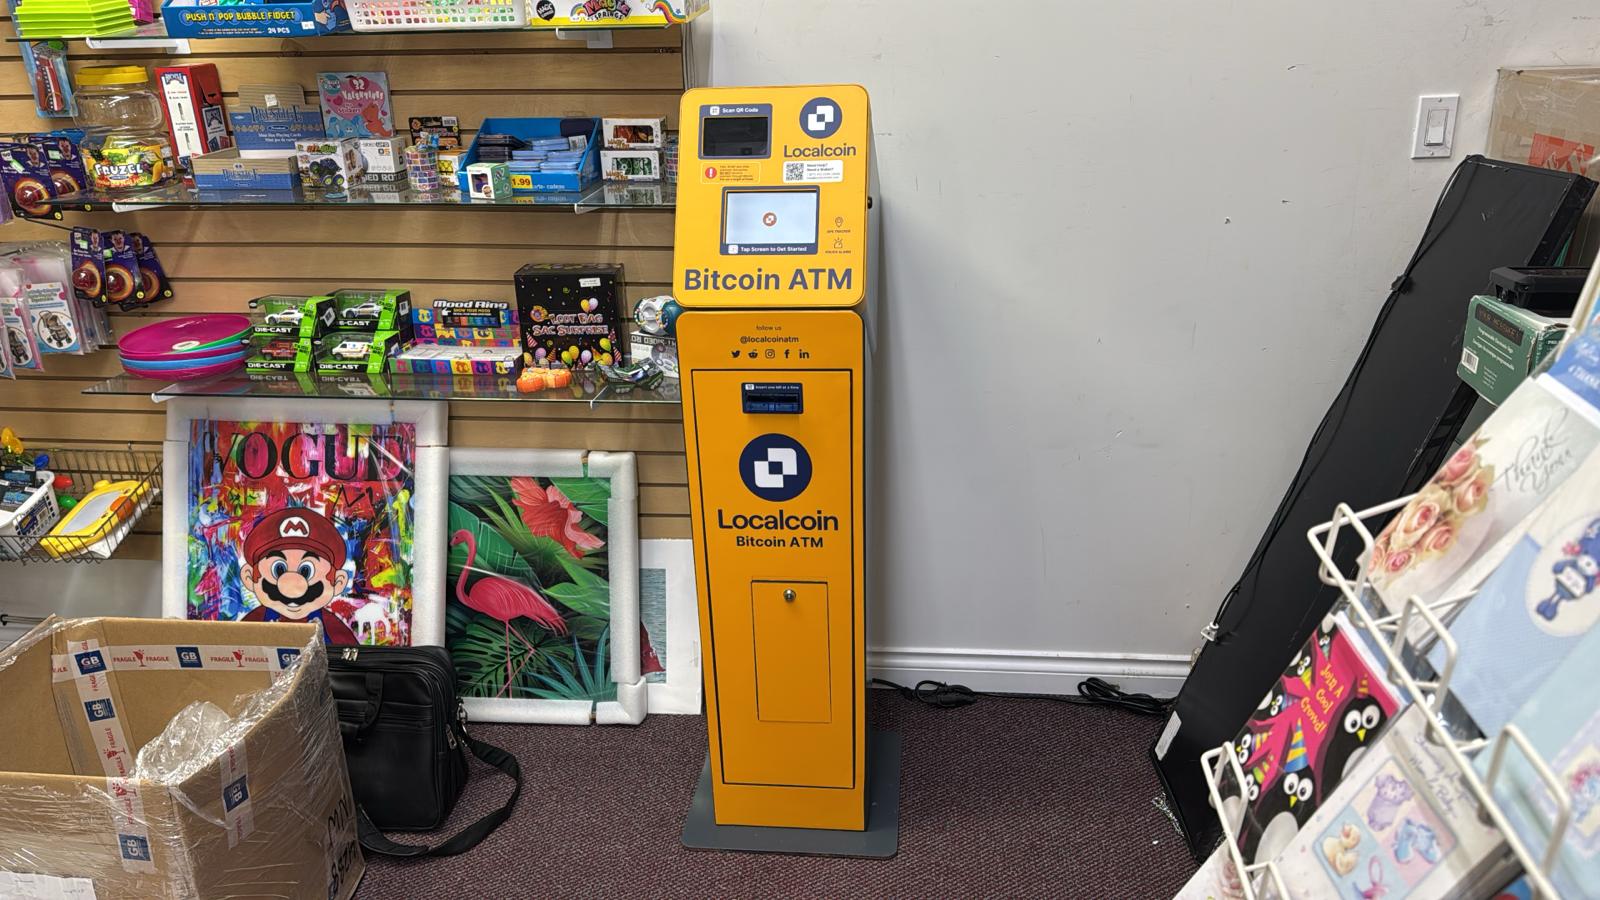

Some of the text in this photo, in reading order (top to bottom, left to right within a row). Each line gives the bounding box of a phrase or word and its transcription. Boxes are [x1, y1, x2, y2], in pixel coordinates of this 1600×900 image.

[218, 12, 234, 21] POP
[236, 12, 265, 20] BUBBLE
[268, 11, 295, 20] FIDGET
[594, 12, 624, 22] SPRINGS
[352, 79, 365, 90] 32
[784, 143, 856, 158] Localcoin
[94, 163, 143, 175] FRUZEL
[512, 178, 531, 186] 1.99
[684, 268, 853, 290] Bitcoin ATM
[433, 300, 509, 309] Mood Ring
[578, 313, 603, 323] BAG
[532, 325, 609, 336] SAC SURPRISE
[740, 335, 799, 344] @localcoinatm
[717, 509, 838, 531] Localcoin
[283, 520, 307, 534] M
[736, 536, 823, 547] Bitcoin ATM
[81, 656, 100, 666] GB
[180, 652, 197, 660] GB
[1320, 663, 1343, 699] Join A
[1316, 688, 1334, 714] Cool
[92, 703, 104, 718] GB
[1300, 697, 1326, 733] Crowd!
[105, 728, 116, 748] FRAGILE
[233, 784, 242, 801] GB
[128, 839, 139, 856] GB
